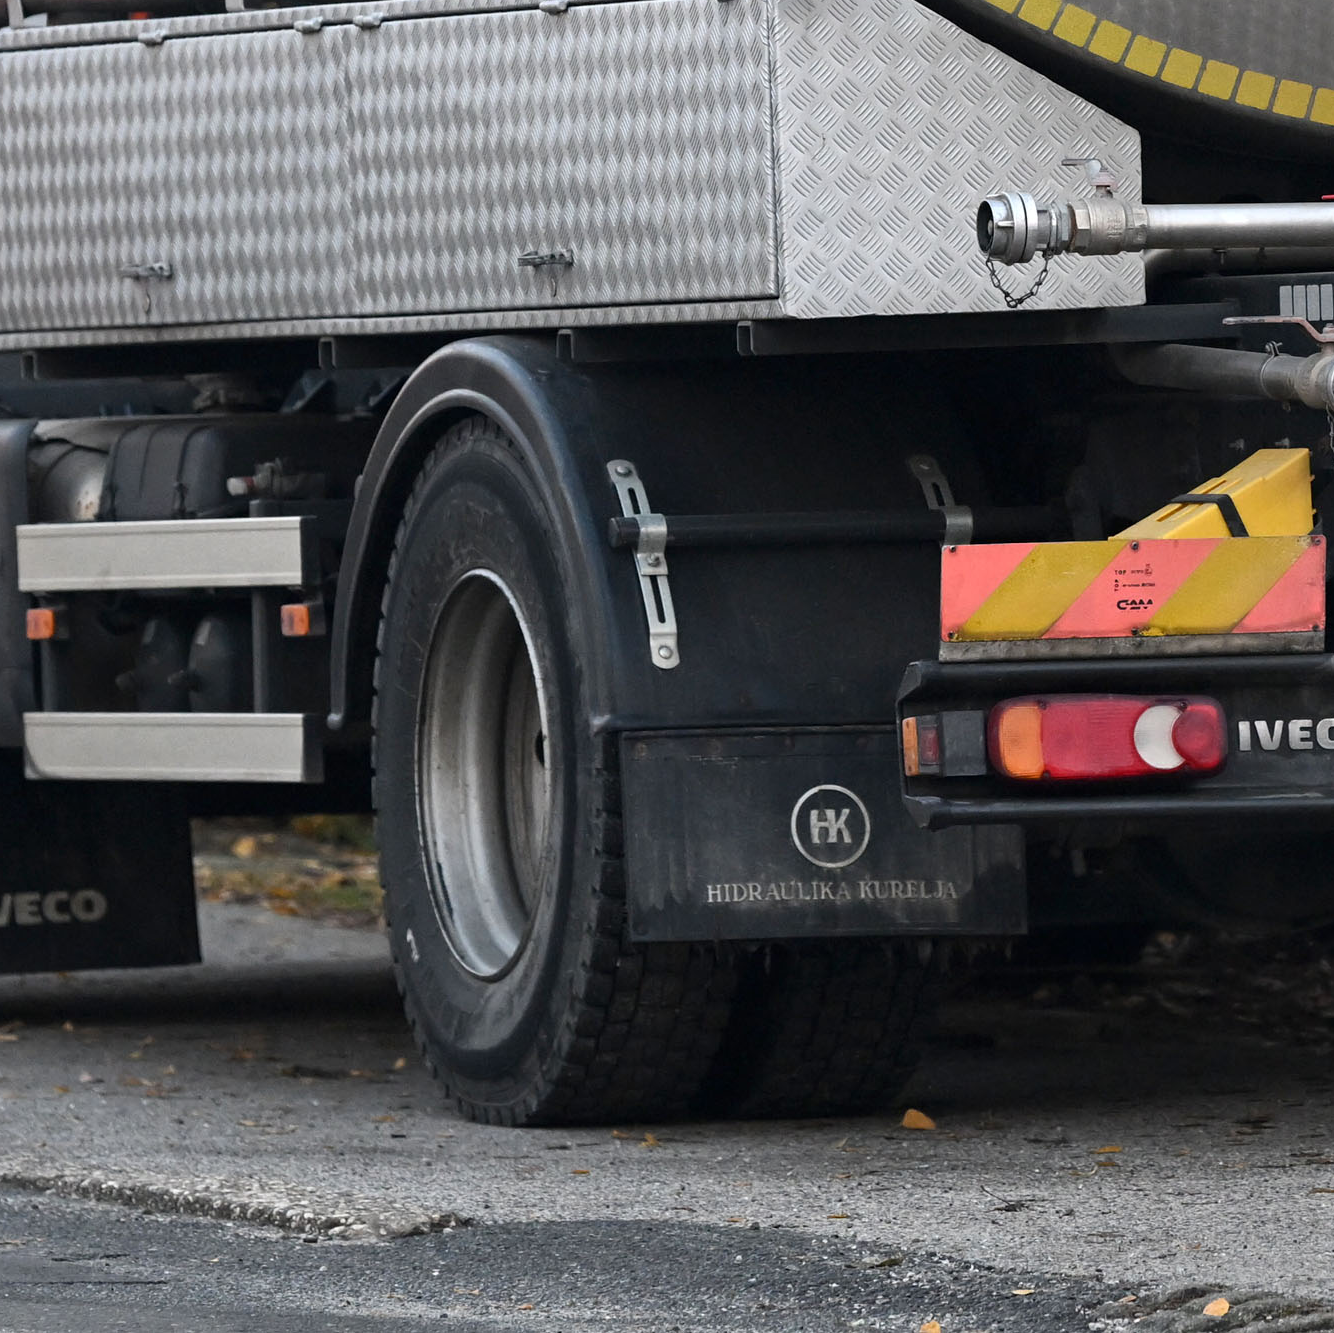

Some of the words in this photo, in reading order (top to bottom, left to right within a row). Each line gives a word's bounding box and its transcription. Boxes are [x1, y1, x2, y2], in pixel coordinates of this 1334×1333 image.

[810, 808, 852, 844] HK
[706, 879, 852, 904] HIDRAULIKA
[859, 878, 958, 901] KURELJA
